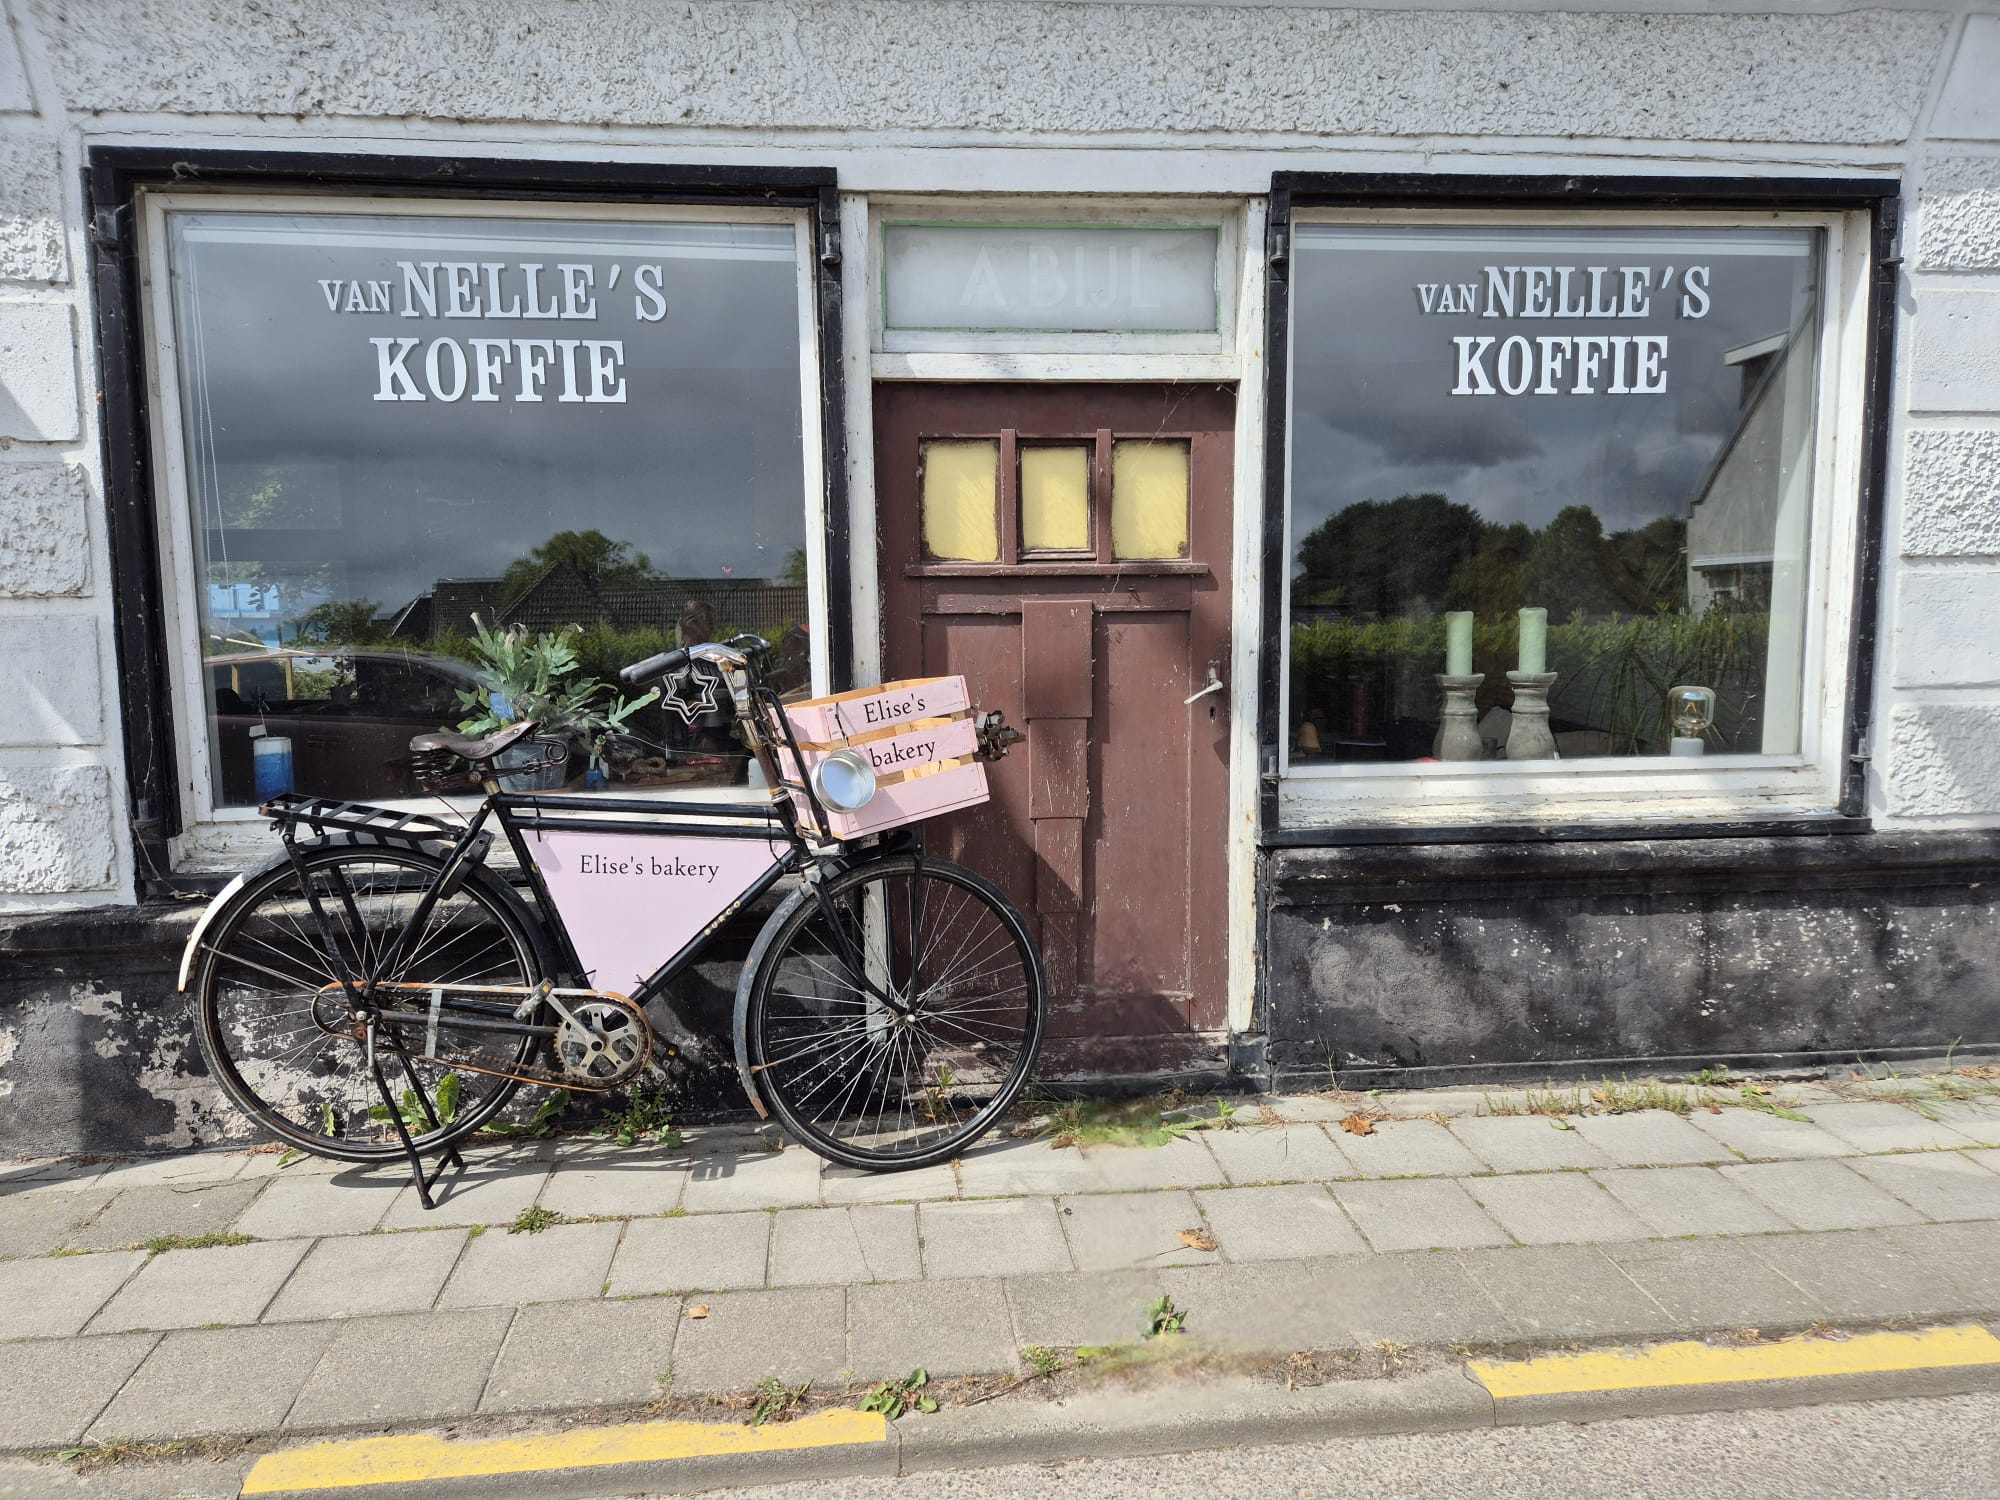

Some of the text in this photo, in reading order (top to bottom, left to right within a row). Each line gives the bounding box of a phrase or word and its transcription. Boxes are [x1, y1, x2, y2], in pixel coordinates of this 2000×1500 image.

[318, 261, 667, 321] VAN NELLE'S
[1417, 266, 1711, 318] VAN NELLE'S
[370, 337, 627, 403] KOFFIE
[1451, 335, 1668, 395] KOFFIE
[863, 694, 926, 724] Elise's
[869, 741, 935, 768] bakery
[580, 854, 719, 883] Elise's bakery
